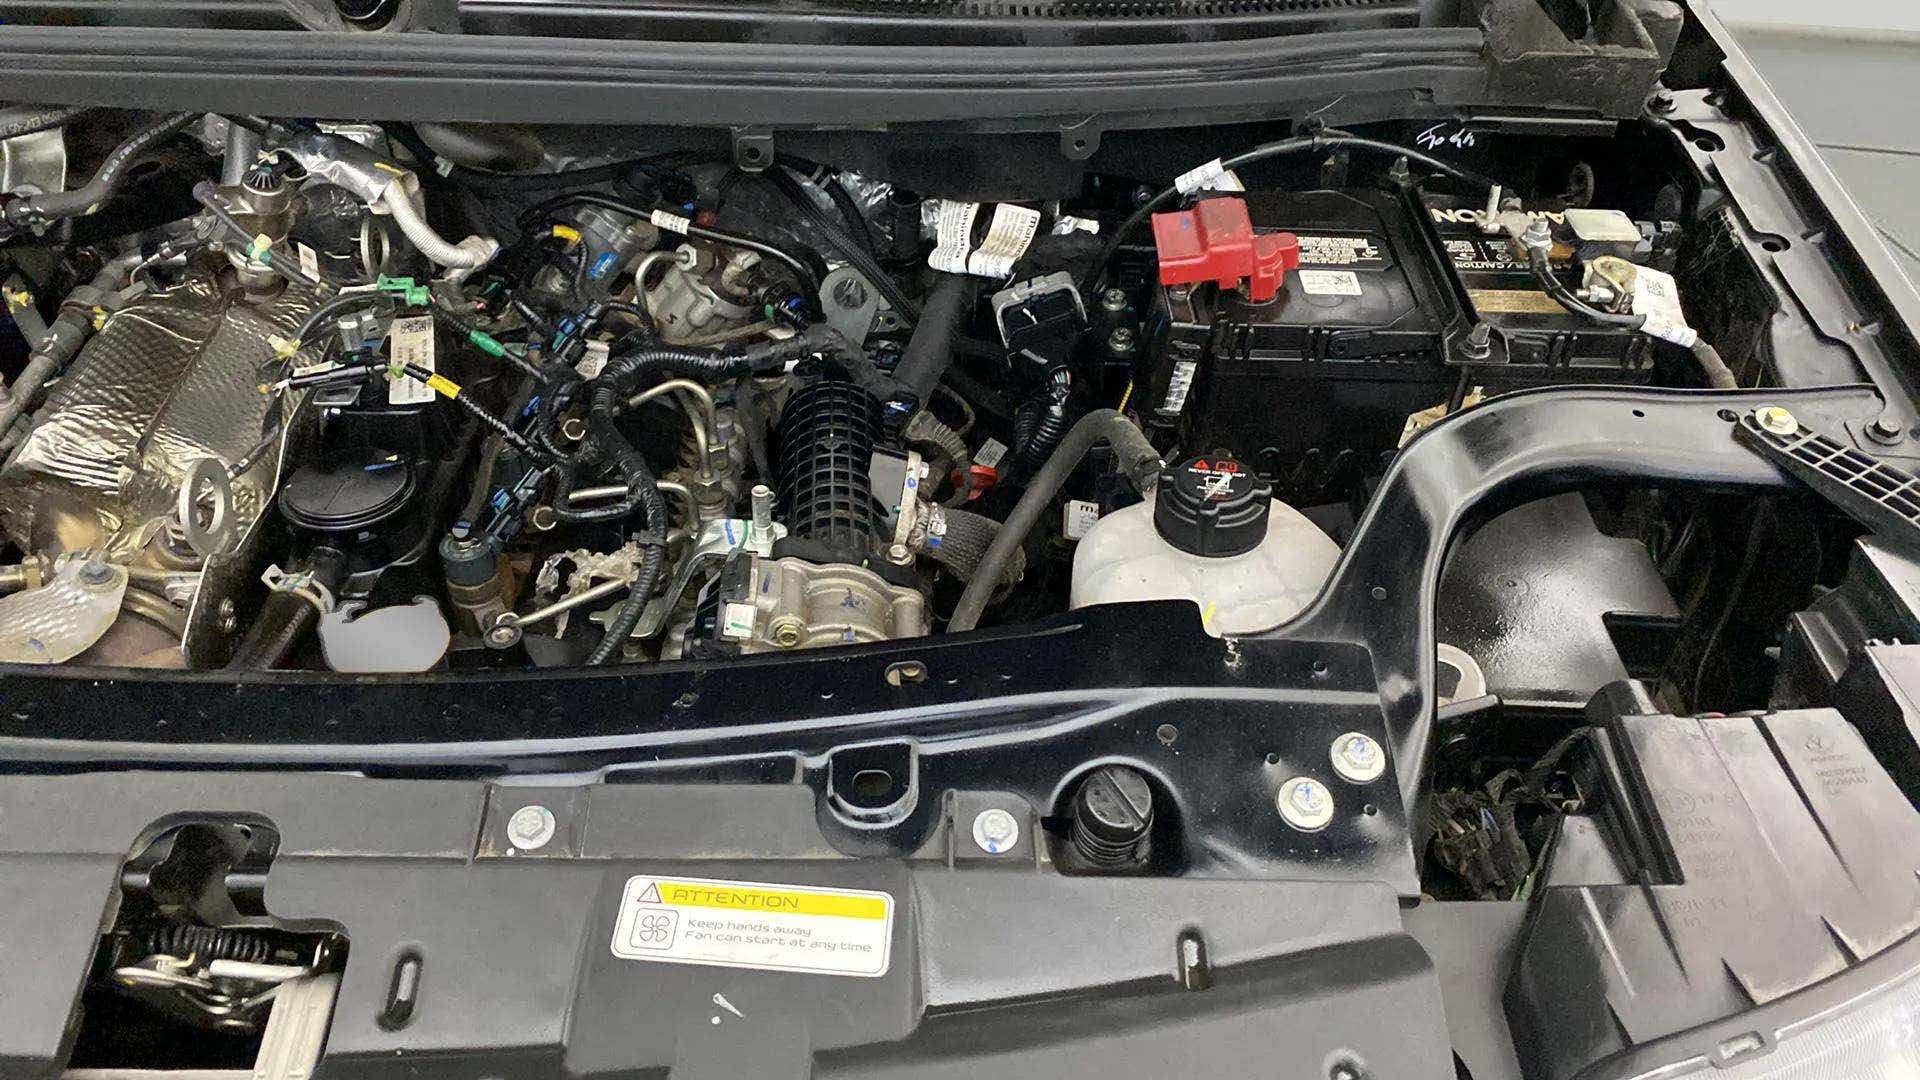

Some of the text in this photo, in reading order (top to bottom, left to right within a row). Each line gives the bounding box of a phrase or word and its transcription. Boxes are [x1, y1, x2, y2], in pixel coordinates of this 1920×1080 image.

[1454, 261, 1505, 269] CAUTION
[672, 888, 800, 909] ATTENTION
[687, 919, 813, 938] Keep hands away
[684, 931, 872, 953] Fan can start at any time
